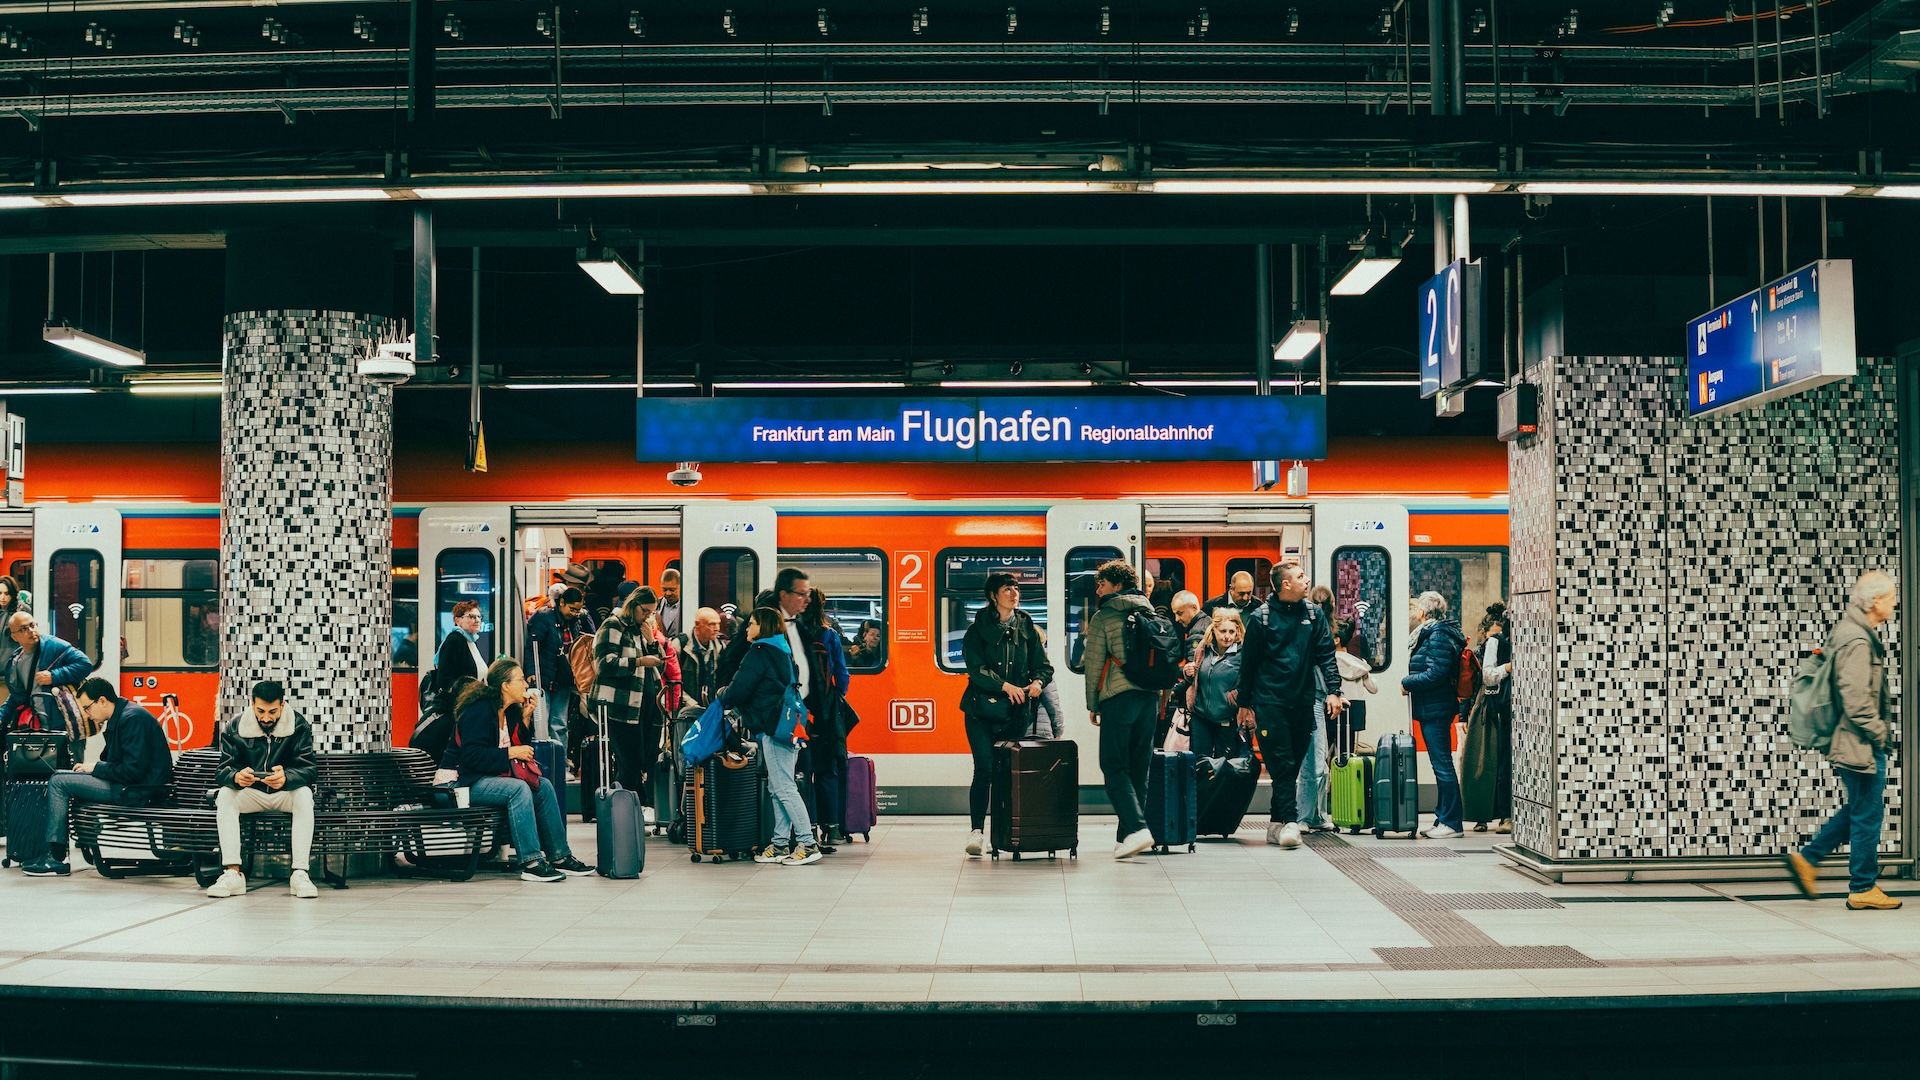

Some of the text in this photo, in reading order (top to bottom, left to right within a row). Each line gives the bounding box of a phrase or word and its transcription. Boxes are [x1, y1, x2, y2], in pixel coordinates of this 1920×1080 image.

[1427, 268, 1458, 367] 2 C
[753, 410, 1214, 449] Frankfurt am Main Flughafen Regionalbahnhof
[900, 554, 922, 589] 2
[895, 704, 930, 726] DB
